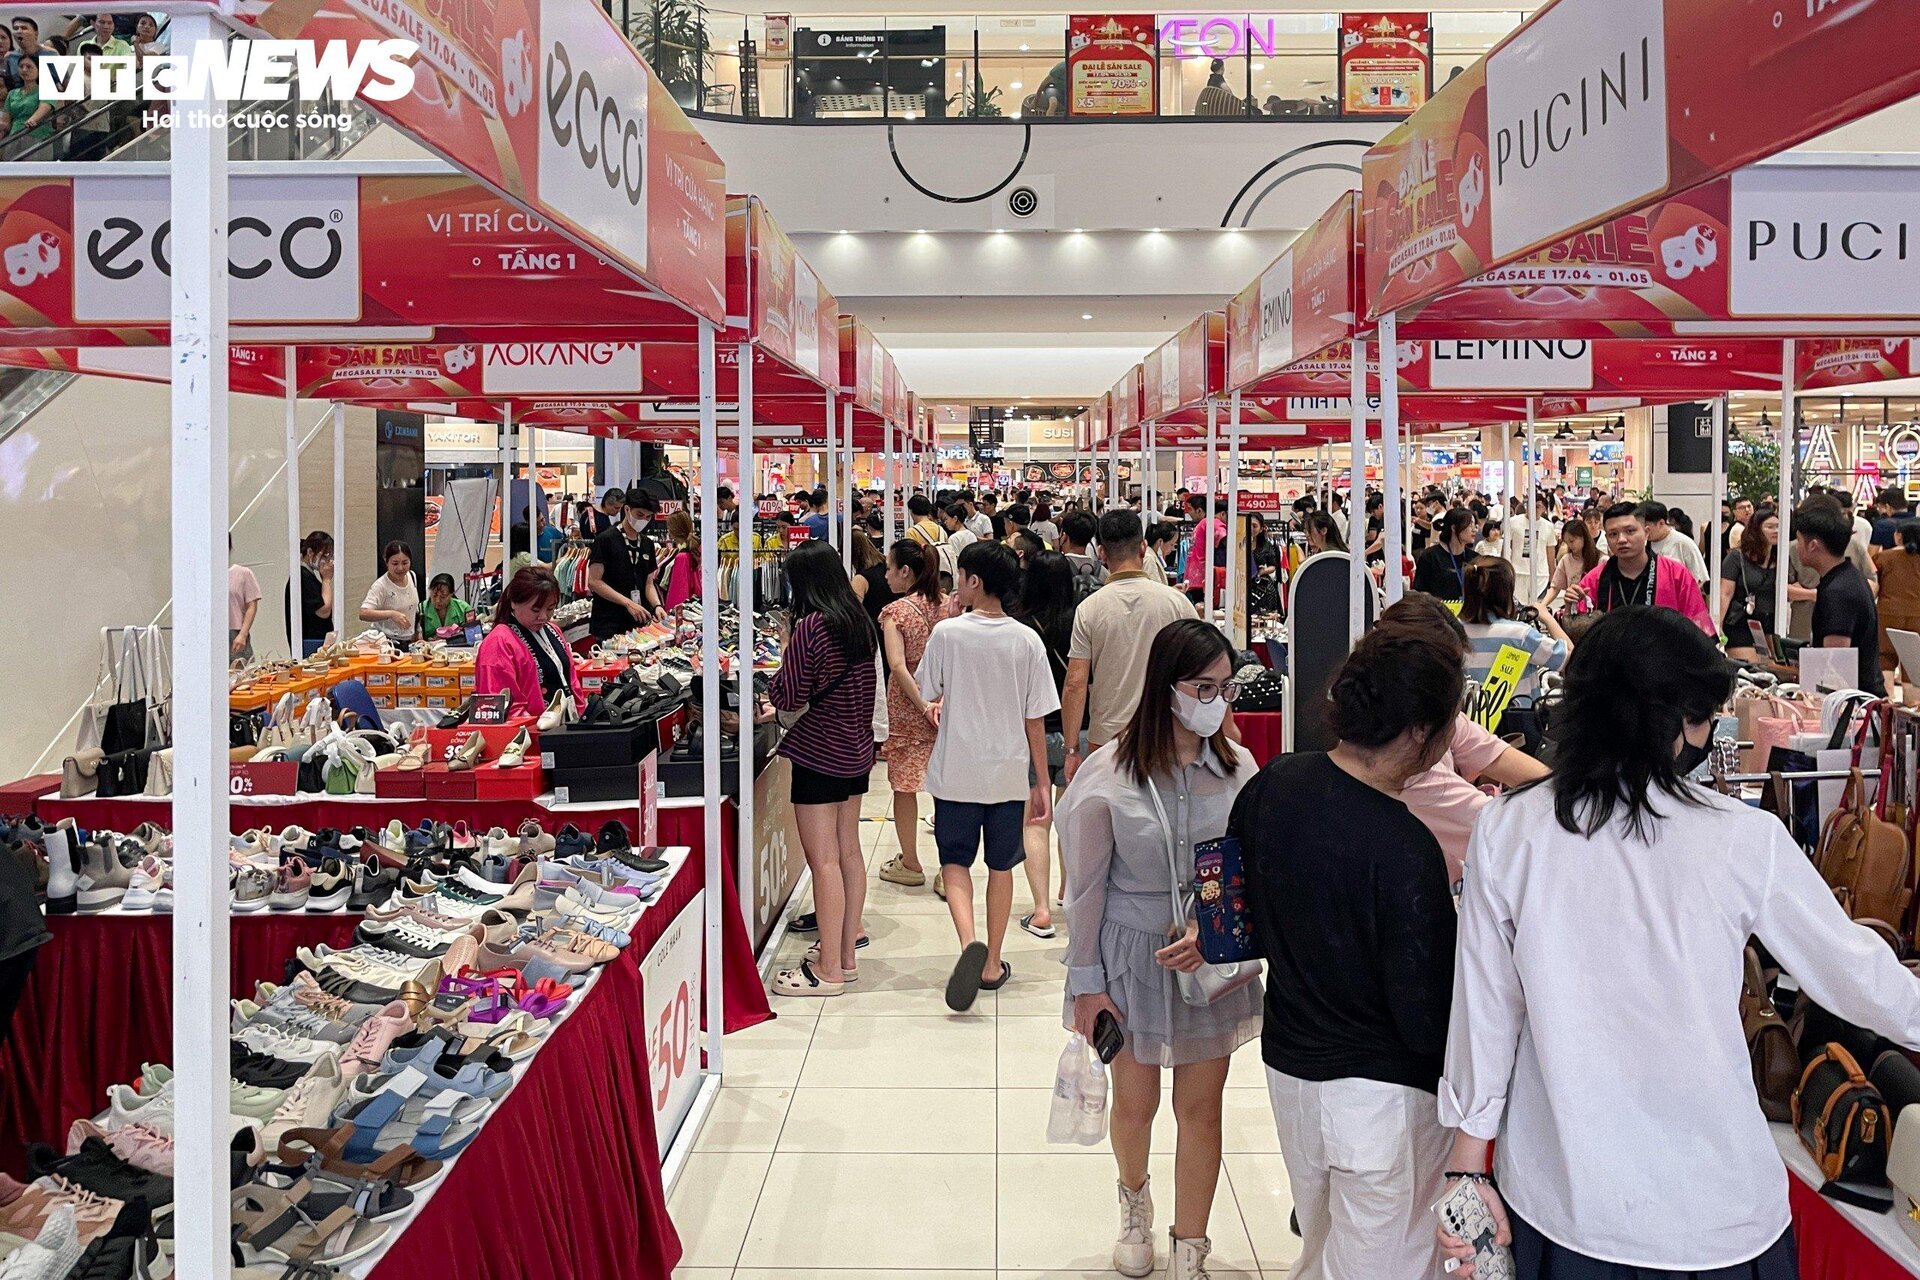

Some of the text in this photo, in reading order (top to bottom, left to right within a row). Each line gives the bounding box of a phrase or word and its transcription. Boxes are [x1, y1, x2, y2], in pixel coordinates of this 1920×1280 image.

[1496, 36, 1649, 186] PUCINI
[546, 40, 643, 206] ecco
[426, 213, 450, 237] VỊ
[459, 208, 500, 233] TRÍ
[498, 247, 576, 270] TẦNG 1
[1552, 269, 1592, 280] 17.04
[1609, 271, 1648, 284] 01.05
[1670, 348, 1717, 361] TẦNG 2
[335, 369, 381, 377] MEGASALE
[415, 369, 437, 377] 01.05
[936, 448, 970, 460] SUPER
[760, 502, 783, 512] 40%
[1246, 500, 1266, 509] 490
[790, 532, 809, 540] SALE
[1500, 664, 1514, 675] SALE
[657, 980, 689, 1112] 50
